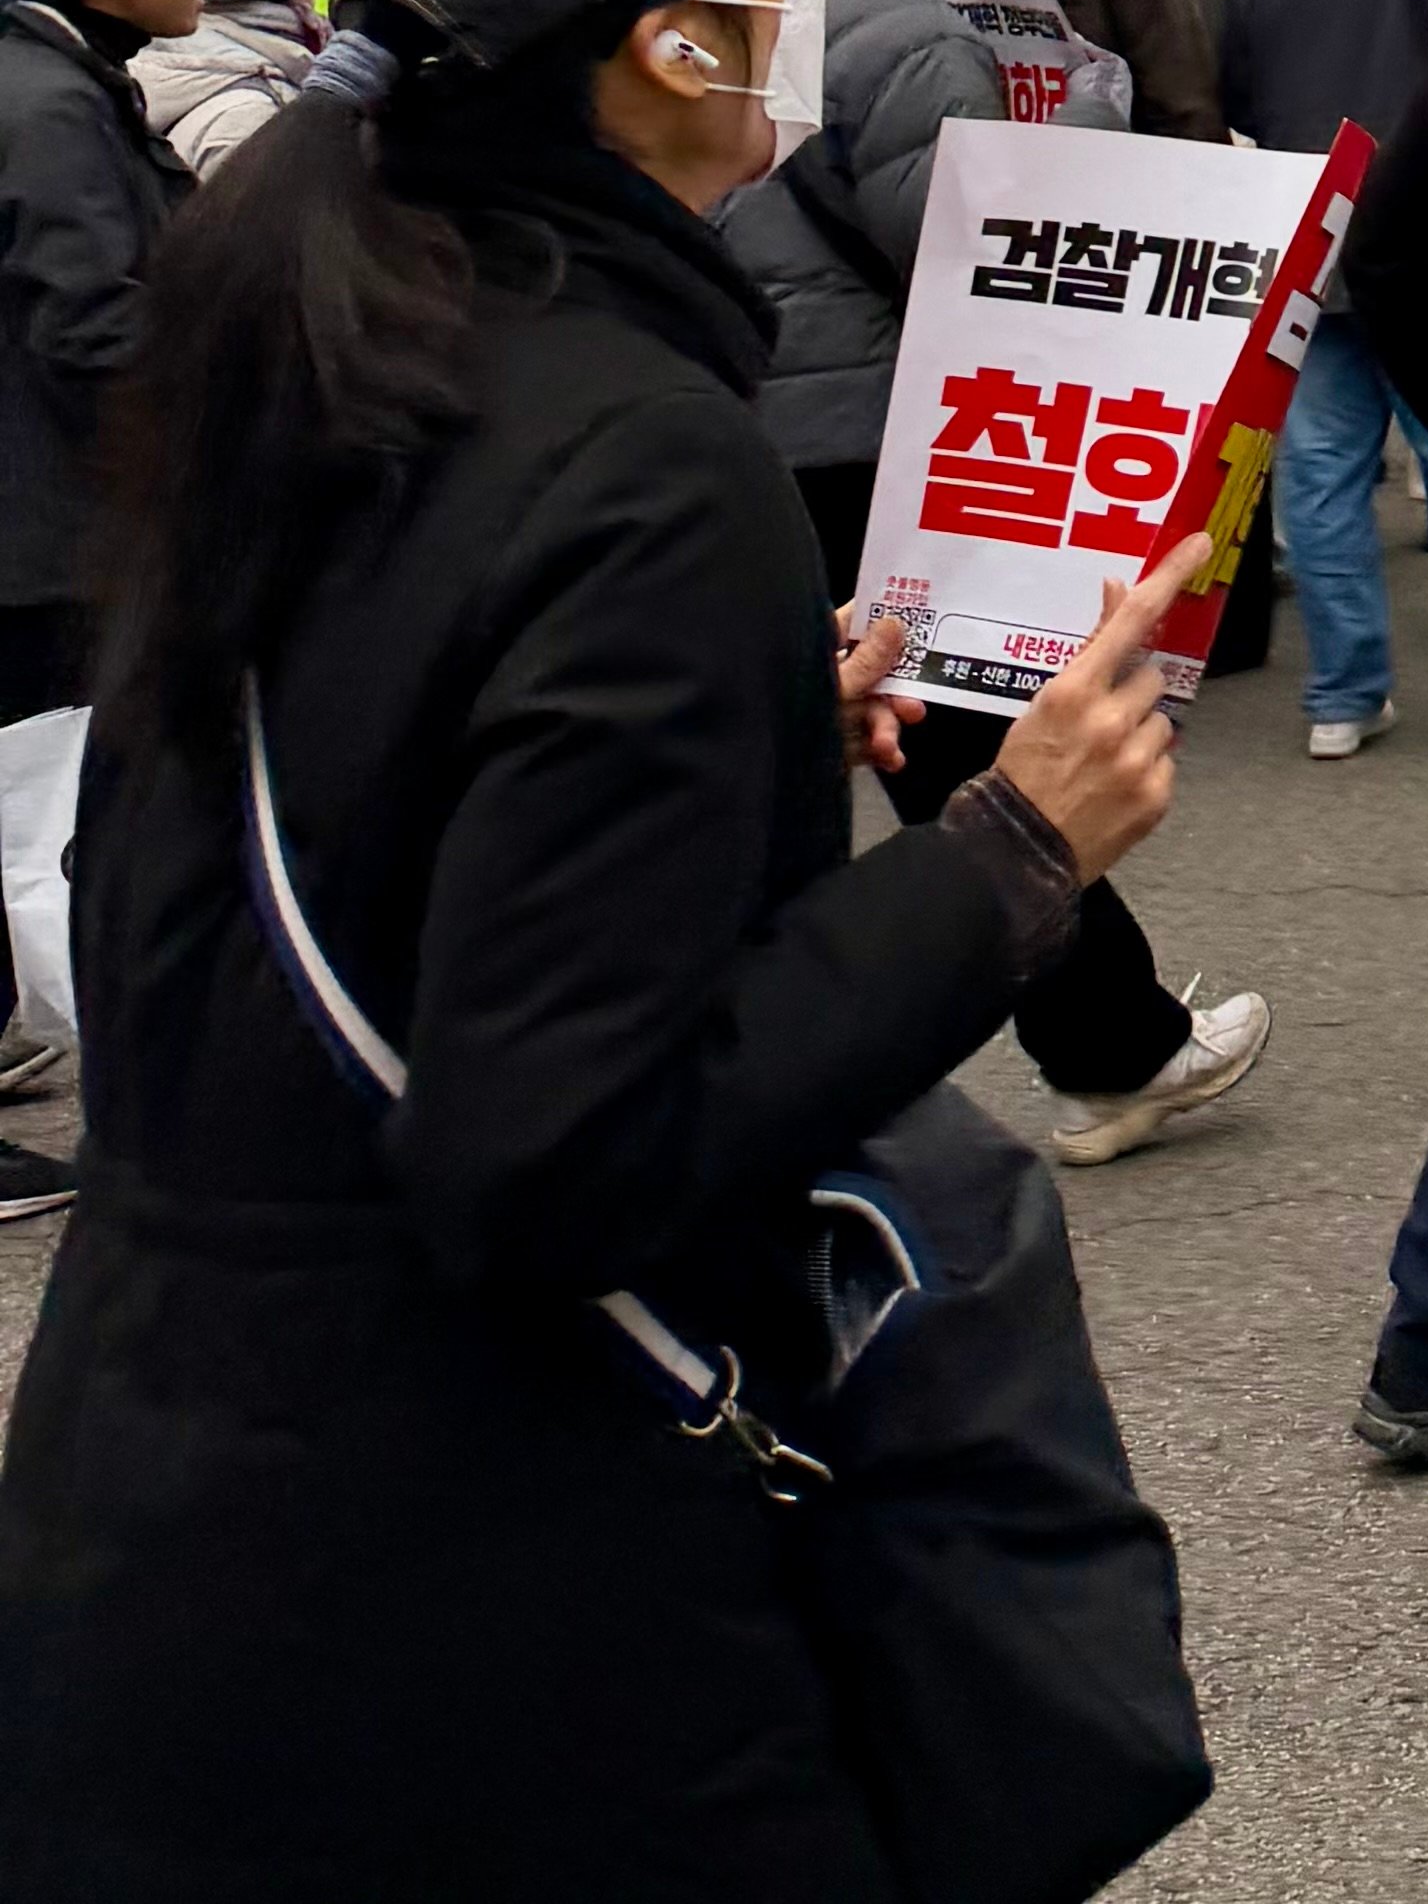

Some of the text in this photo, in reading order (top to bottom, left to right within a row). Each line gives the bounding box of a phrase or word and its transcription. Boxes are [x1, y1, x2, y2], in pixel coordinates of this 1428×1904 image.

[970, 217, 1283, 323] 검찰개혁
[942, 659, 972, 680] 후원
[981, 662, 1013, 687] 신한
[1013, 670, 1053, 693] 100-
